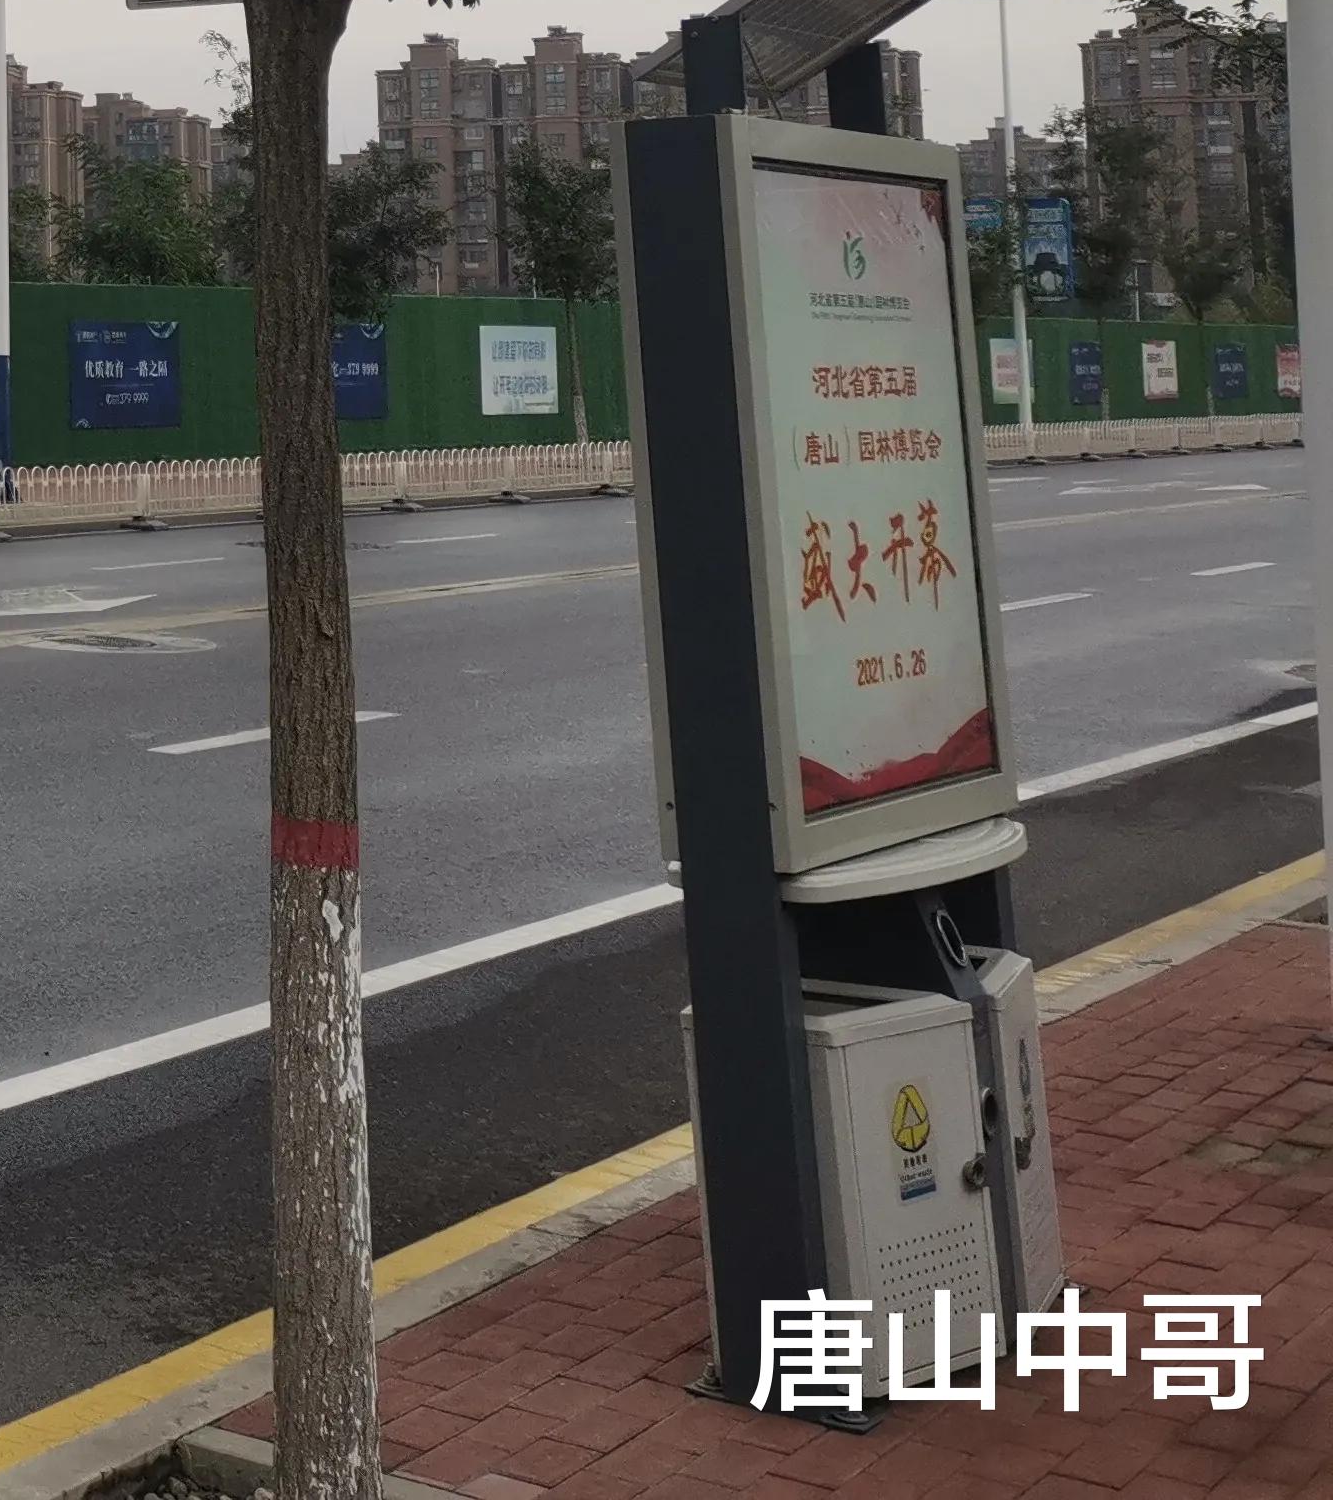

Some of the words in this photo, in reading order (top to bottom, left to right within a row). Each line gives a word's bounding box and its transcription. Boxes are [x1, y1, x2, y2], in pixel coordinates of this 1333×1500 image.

[812, 364, 917, 399] 河北省第五届
[800, 497, 957, 624] 盛大开幕
